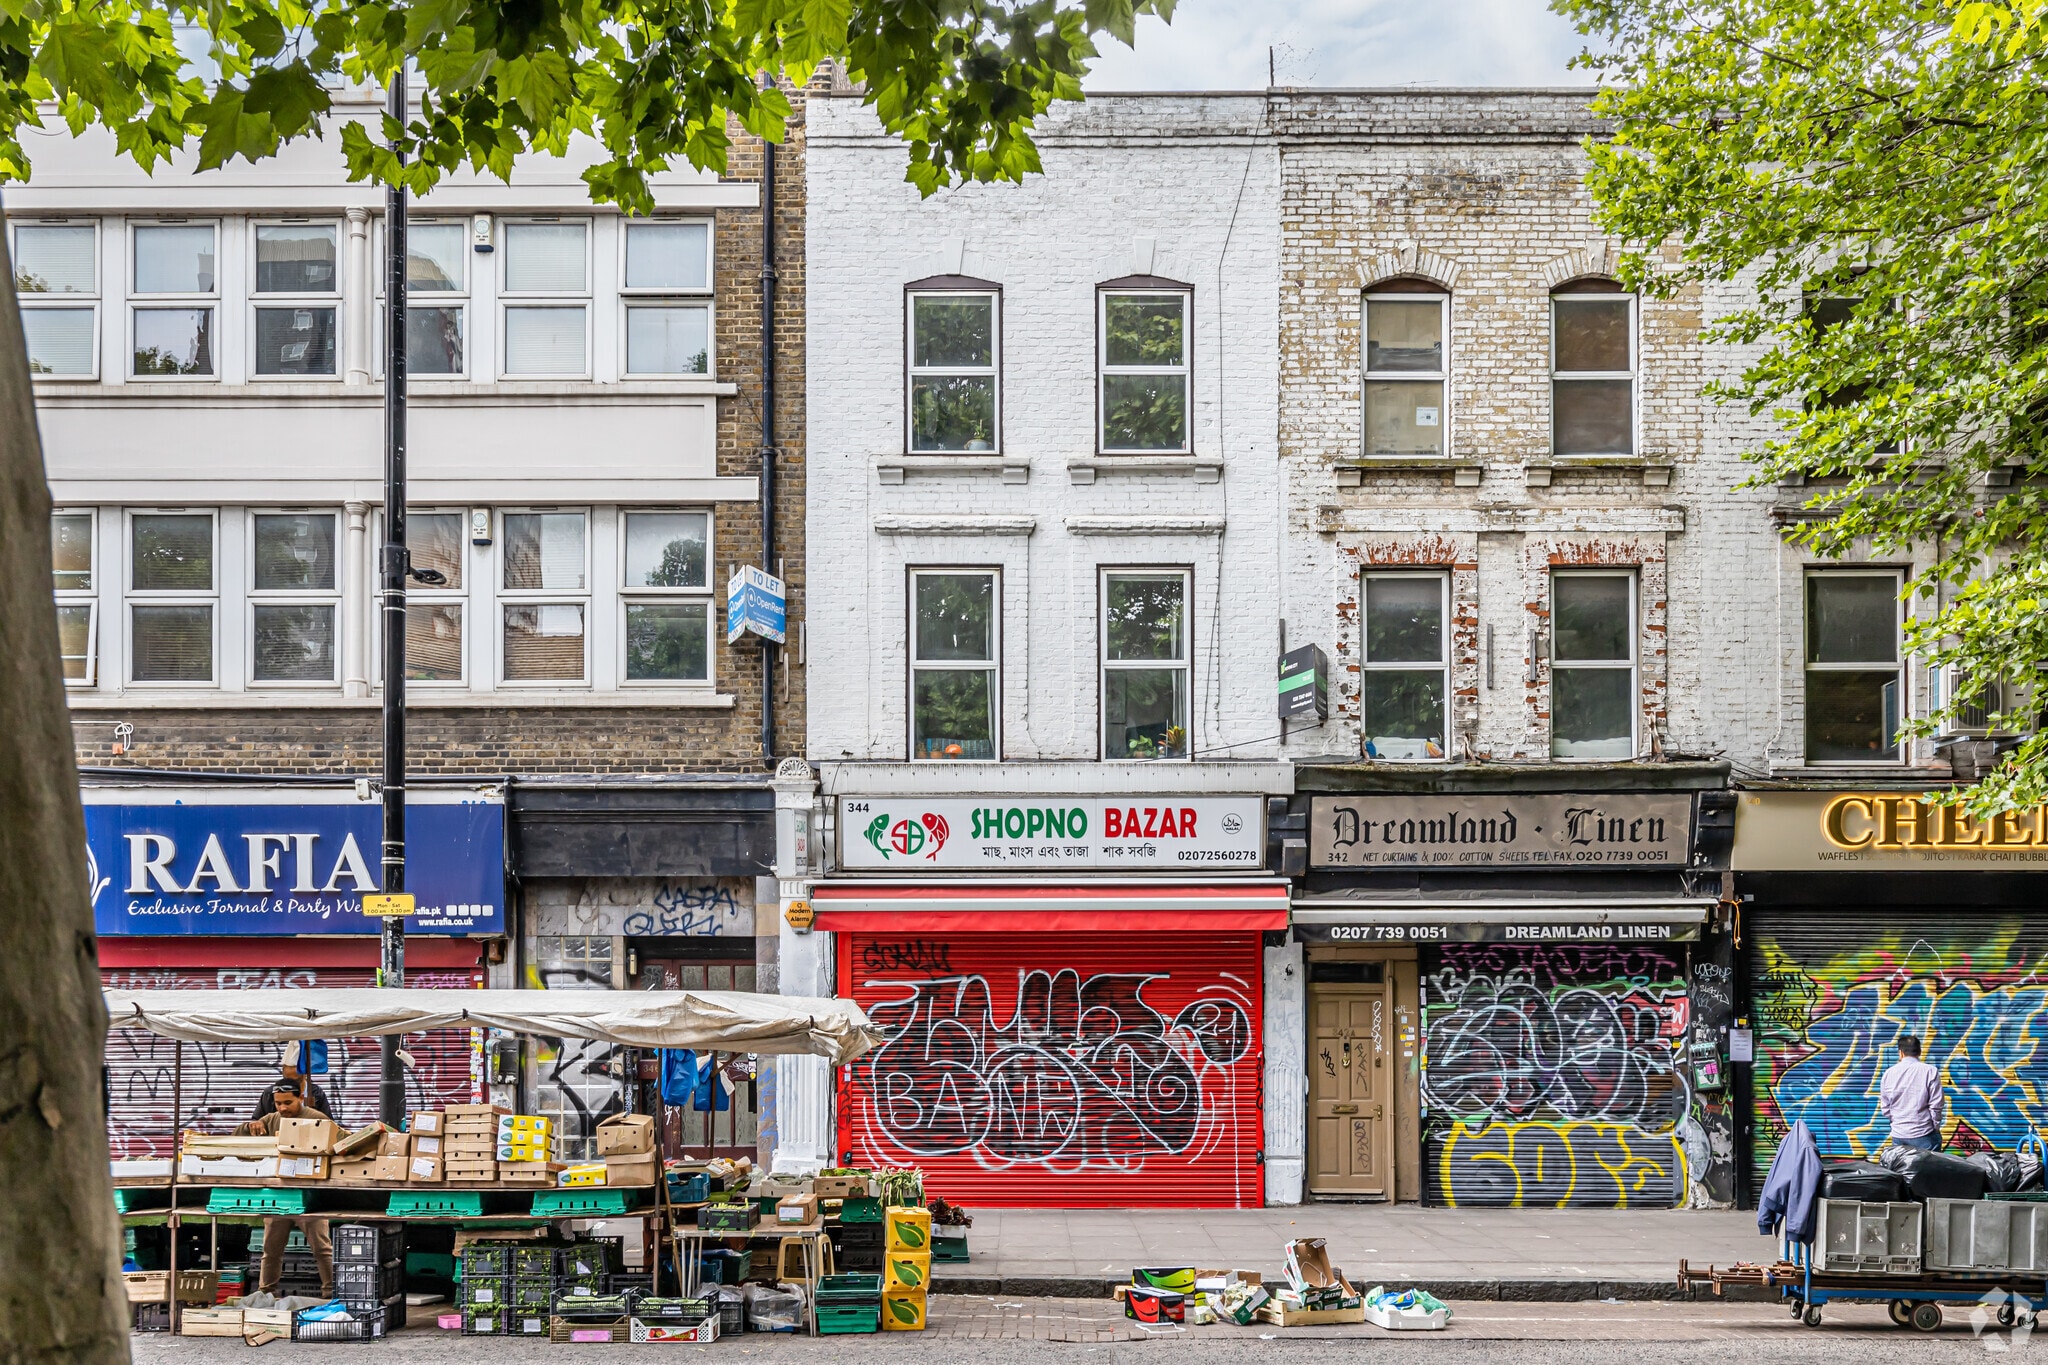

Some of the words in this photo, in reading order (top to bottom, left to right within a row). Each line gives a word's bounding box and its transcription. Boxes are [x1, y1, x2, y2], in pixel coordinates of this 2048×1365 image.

[752, 571, 763, 586] TO
[765, 577, 779, 593] LET
[847, 803, 870, 813] 344
[971, 807, 1088, 840] SHOPNO
[1104, 807, 1198, 839] BAZAR
[1333, 805, 1517, 849] Dreamland
[1564, 807, 1670, 846] Linen
[1822, 794, 2048, 847] CHEE
[1009, 845, 1034, 859] মাংস
[1037, 846, 1061, 859] এবং
[1063, 846, 1089, 858] তাজা
[1178, 850, 1257, 861] 02072560278
[1328, 852, 1348, 863] 342
[1362, 852, 1380, 862] NET
[1382, 852, 1418, 862] CURTAINS
[1421, 851, 1428, 862] &
[1432, 852, 1453, 862] 100%
[1459, 852, 1493, 862] COTTON
[1499, 851, 1529, 862] SHEETS
[1606, 851, 1633, 861] 7739
[1637, 850, 1668, 861] 0051
[1818, 851, 1859, 861] WAFFLES
[1958, 851, 1987, 861] KARAK
[1990, 851, 2011, 861] CHAI
[123, 832, 380, 893] RAFIA
[127, 899, 203, 915] Exclusive
[207, 897, 268, 914] Formal
[274, 899, 283, 912] &
[287, 899, 331, 919] Party
[336, 899, 362, 913] We
[418, 917, 474, 926] www.rafia.co.uk
[1331, 926, 1373, 939] 0207
[1375, 926, 1405, 939] 739
[1408, 926, 1448, 939] 0051
[1505, 925, 1614, 939] DREAMLAND
[1618, 925, 1671, 939] LINEN
